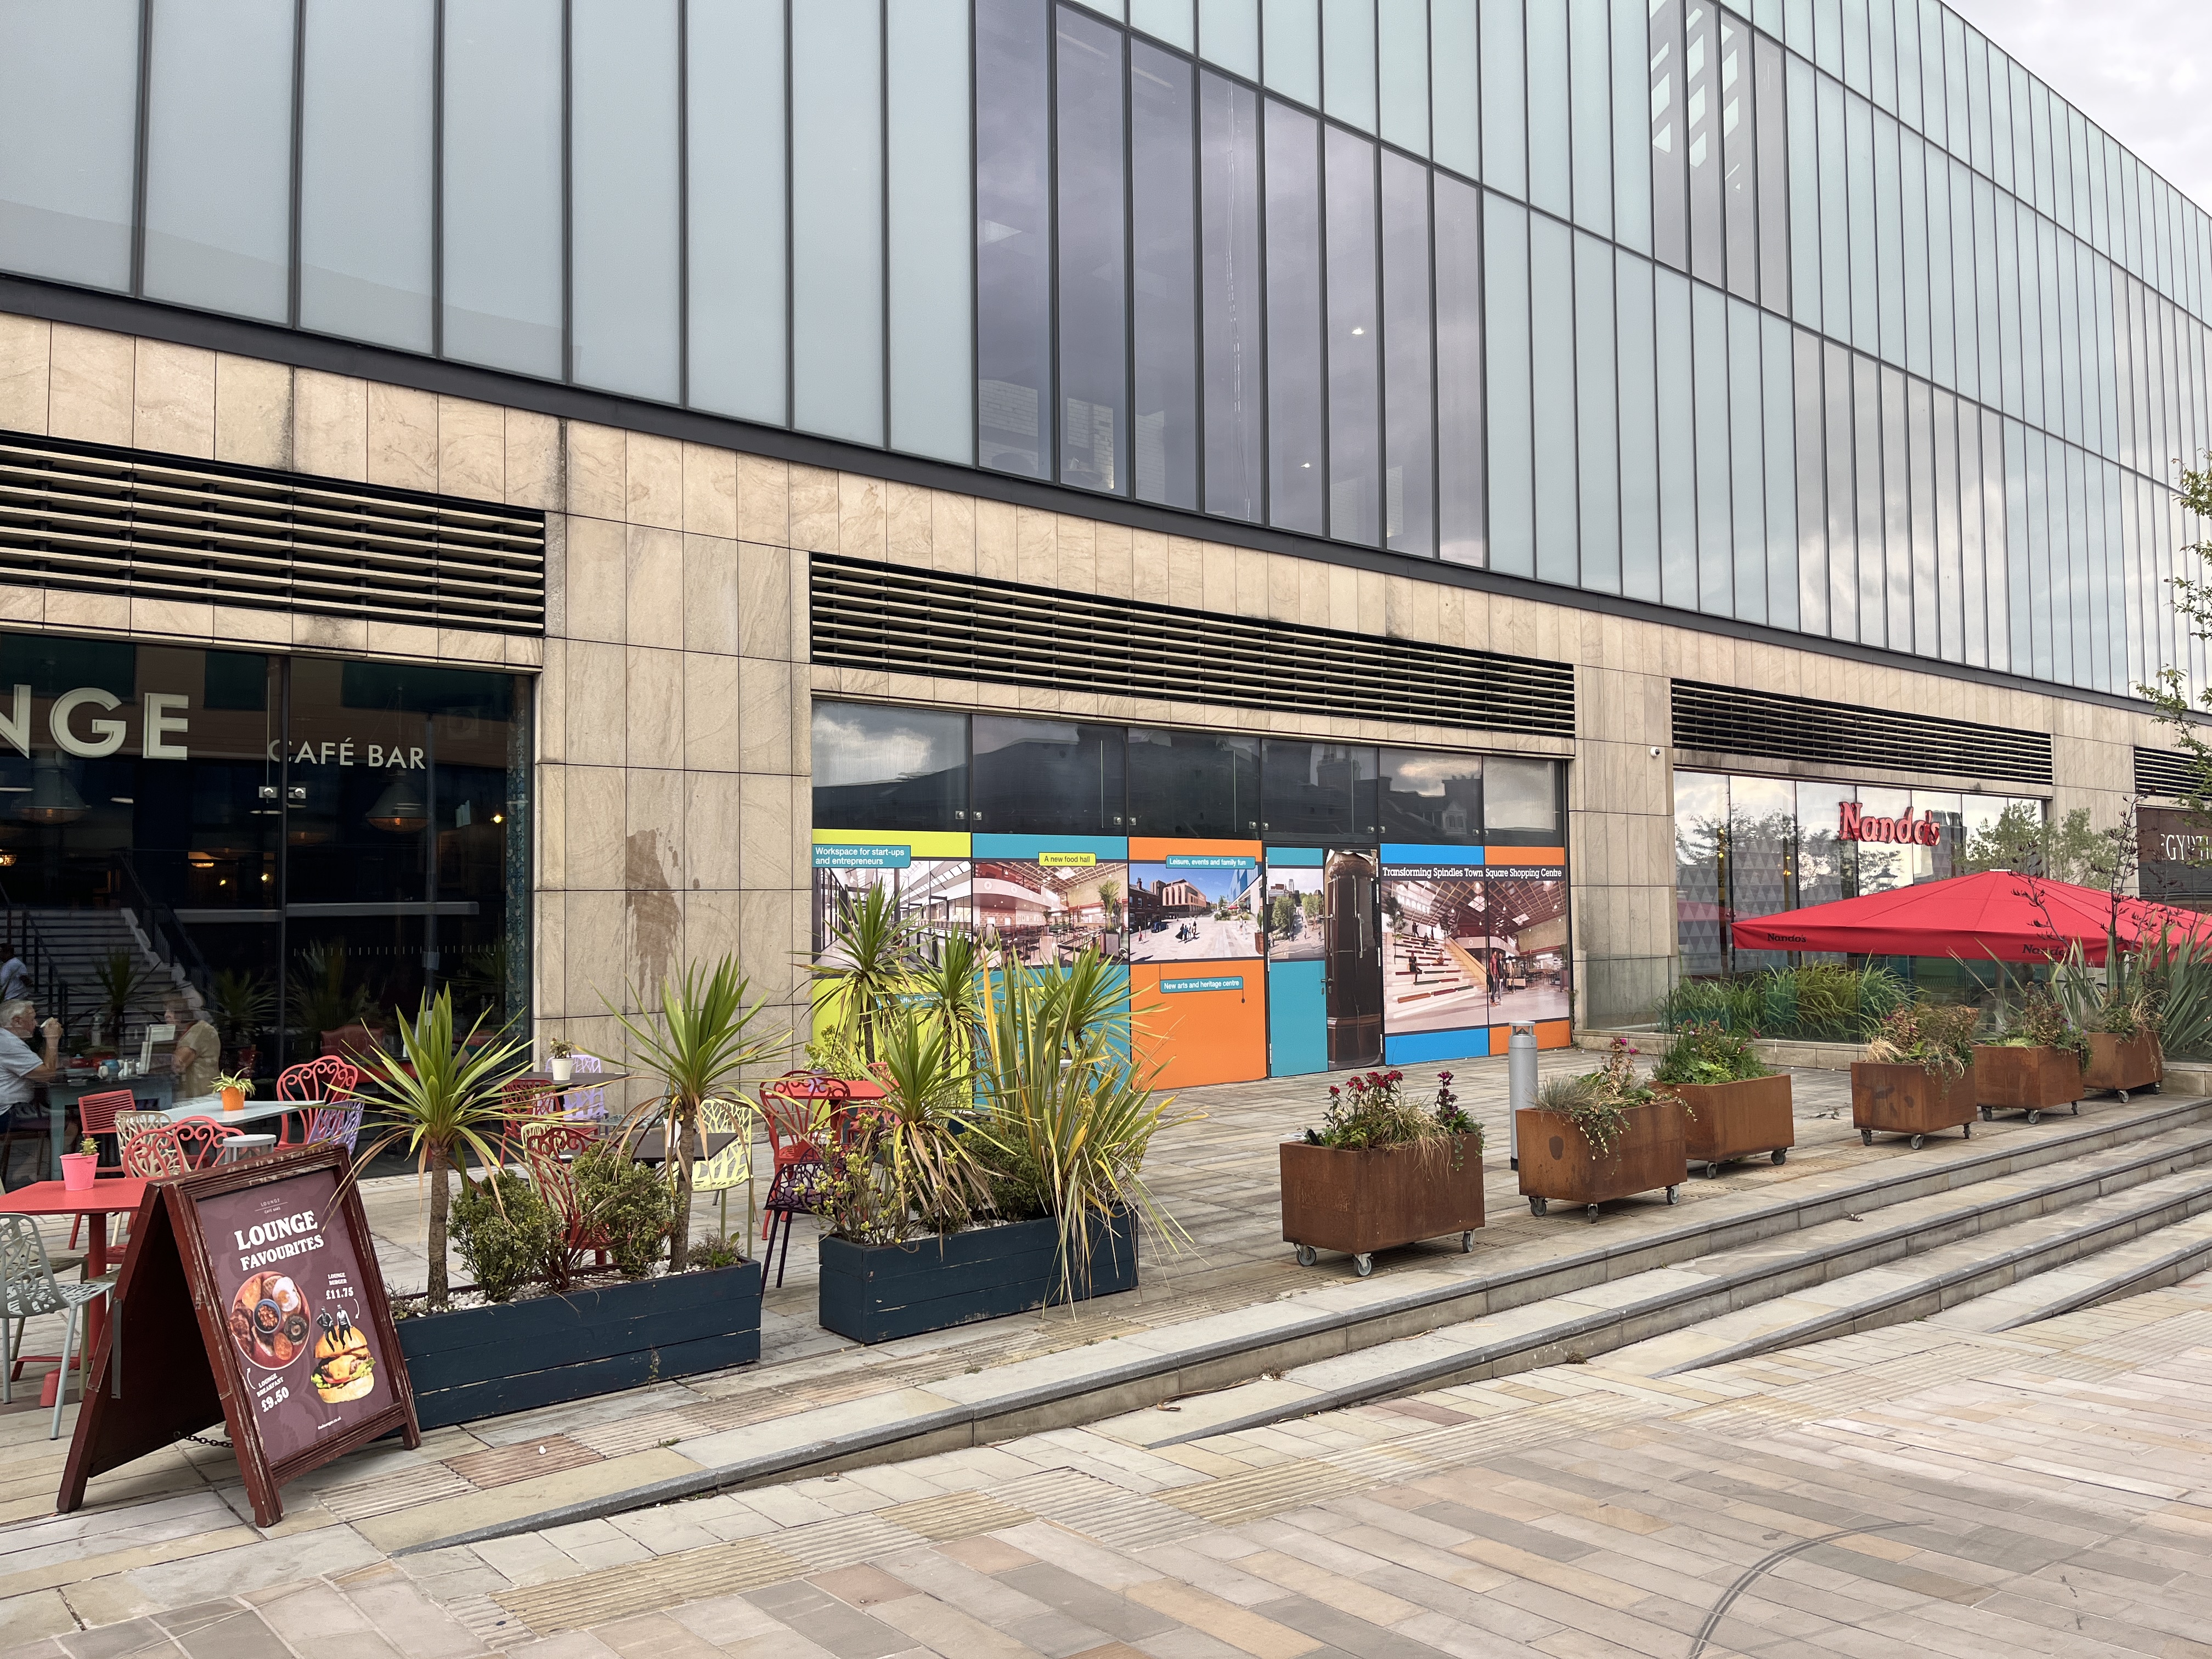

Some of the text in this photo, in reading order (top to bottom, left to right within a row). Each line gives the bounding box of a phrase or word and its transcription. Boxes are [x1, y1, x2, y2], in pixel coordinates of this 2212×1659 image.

[268, 737, 426, 769] CAFÉ BAR
[1839, 802, 1940, 847] Nando's
[815, 847, 905, 857] Workspace for start-ups
[2160, 834, 2210, 860] GYPTI
[832, 857, 883, 866] entrepreneurs
[1221, 859, 1237, 867] family
[1382, 867, 1562, 879] Transforming Spindles Town Square Shopping Centre
[1397, 894, 1431, 914] MARKET
[1767, 933, 1807, 943] Nando's
[1200, 980, 1221, 989] heritage
[234, 1210, 318, 1250] LOUNGE
[240, 1234, 324, 1271] FAVOURITES
[326, 1286, 354, 1300] £11.75
[256, 1376, 284, 1397] BREAKFAST
[258, 1373, 278, 1389] LOUNGE
[261, 1386, 289, 1412] £9.50
